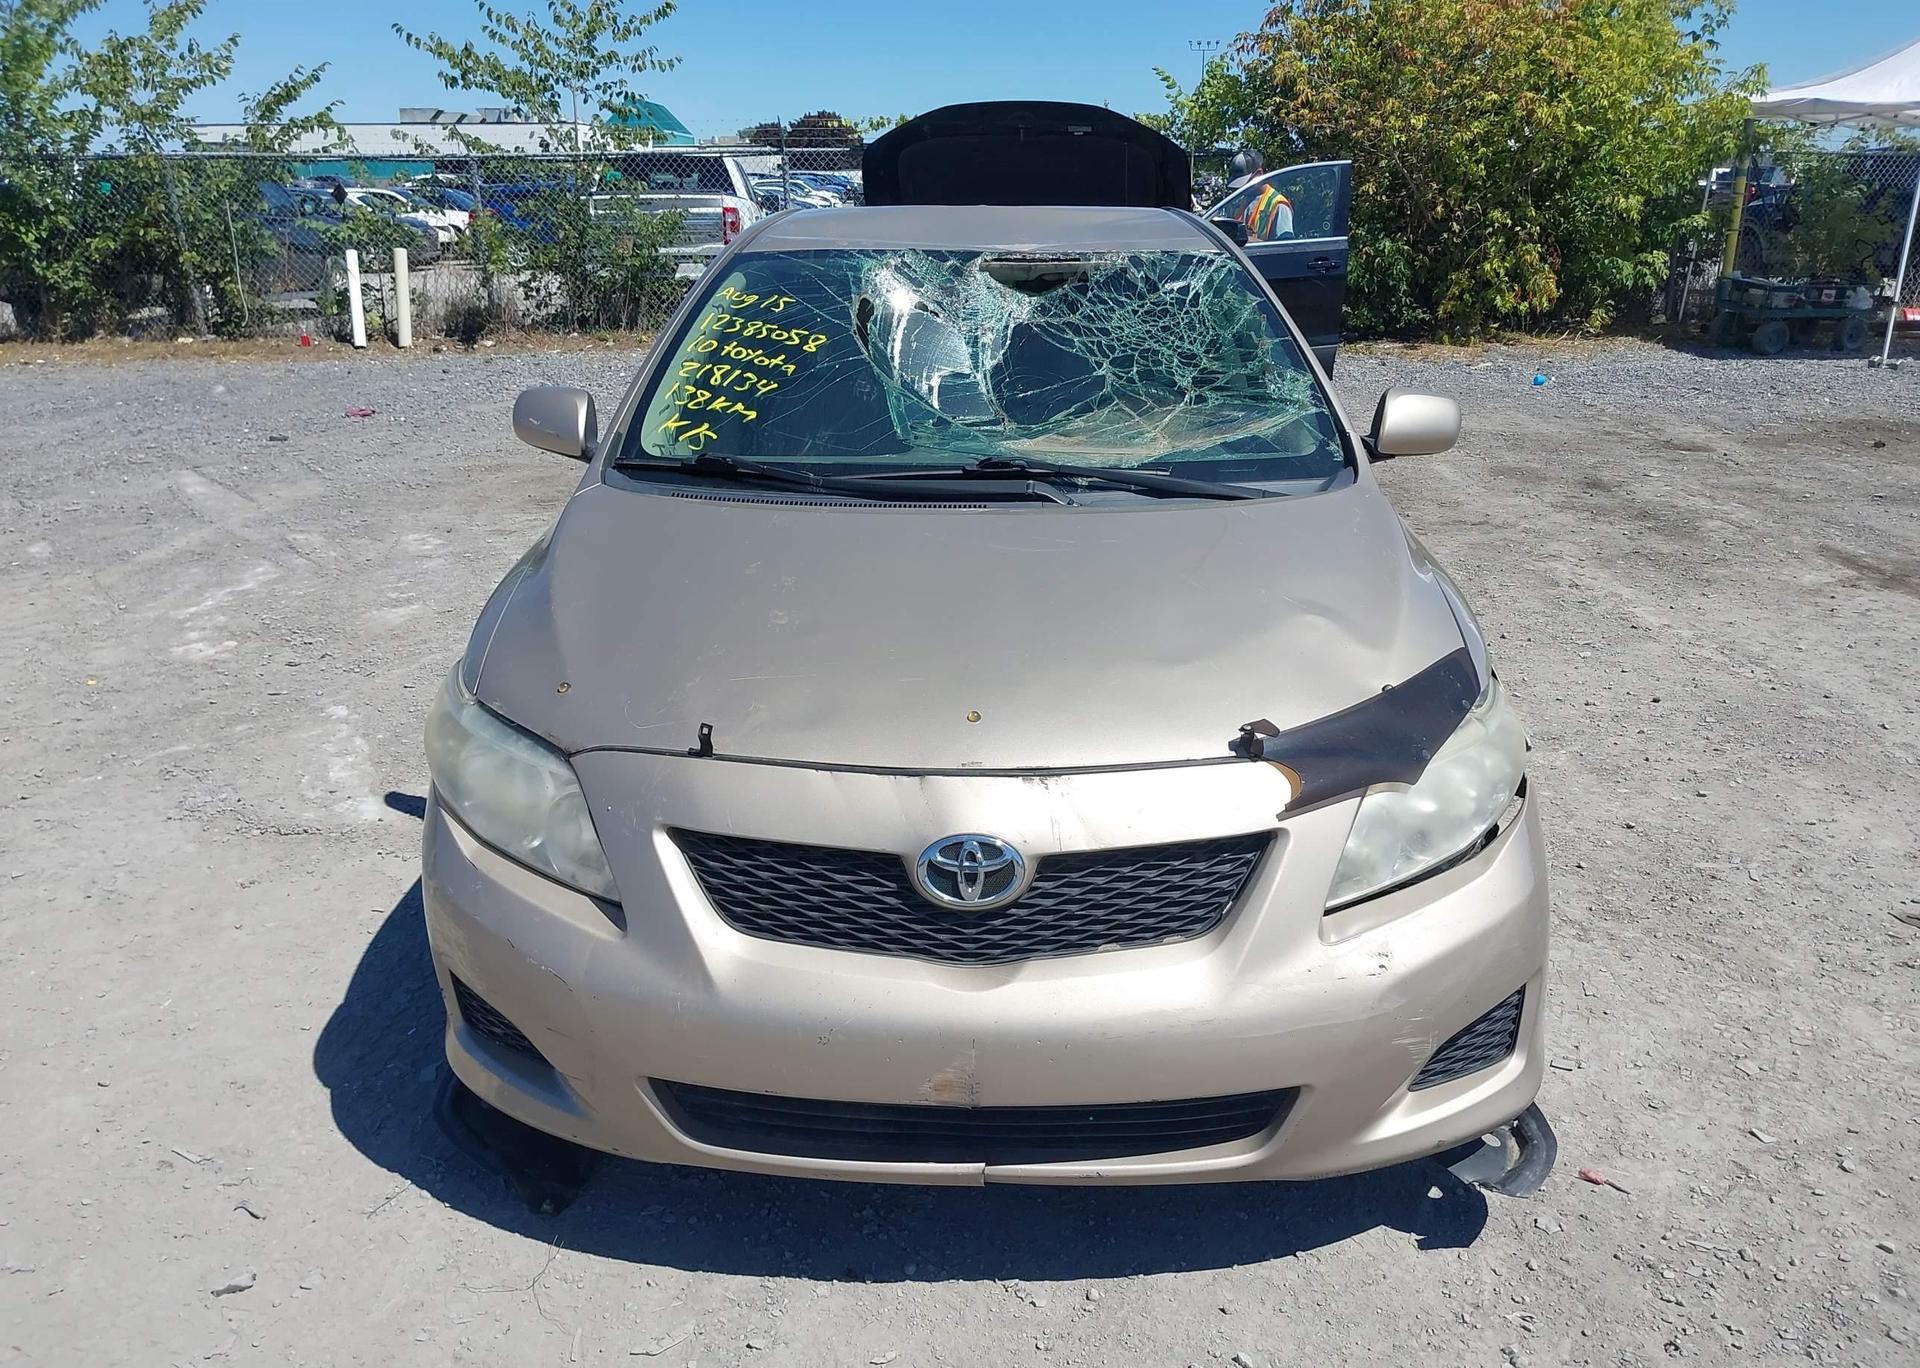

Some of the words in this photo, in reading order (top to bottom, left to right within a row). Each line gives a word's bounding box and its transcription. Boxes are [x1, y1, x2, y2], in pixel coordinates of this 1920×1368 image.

[760, 294, 796, 312] 15
[688, 335, 718, 352] 10
[701, 313, 827, 352] 12385058
[679, 362, 778, 397] 218134
